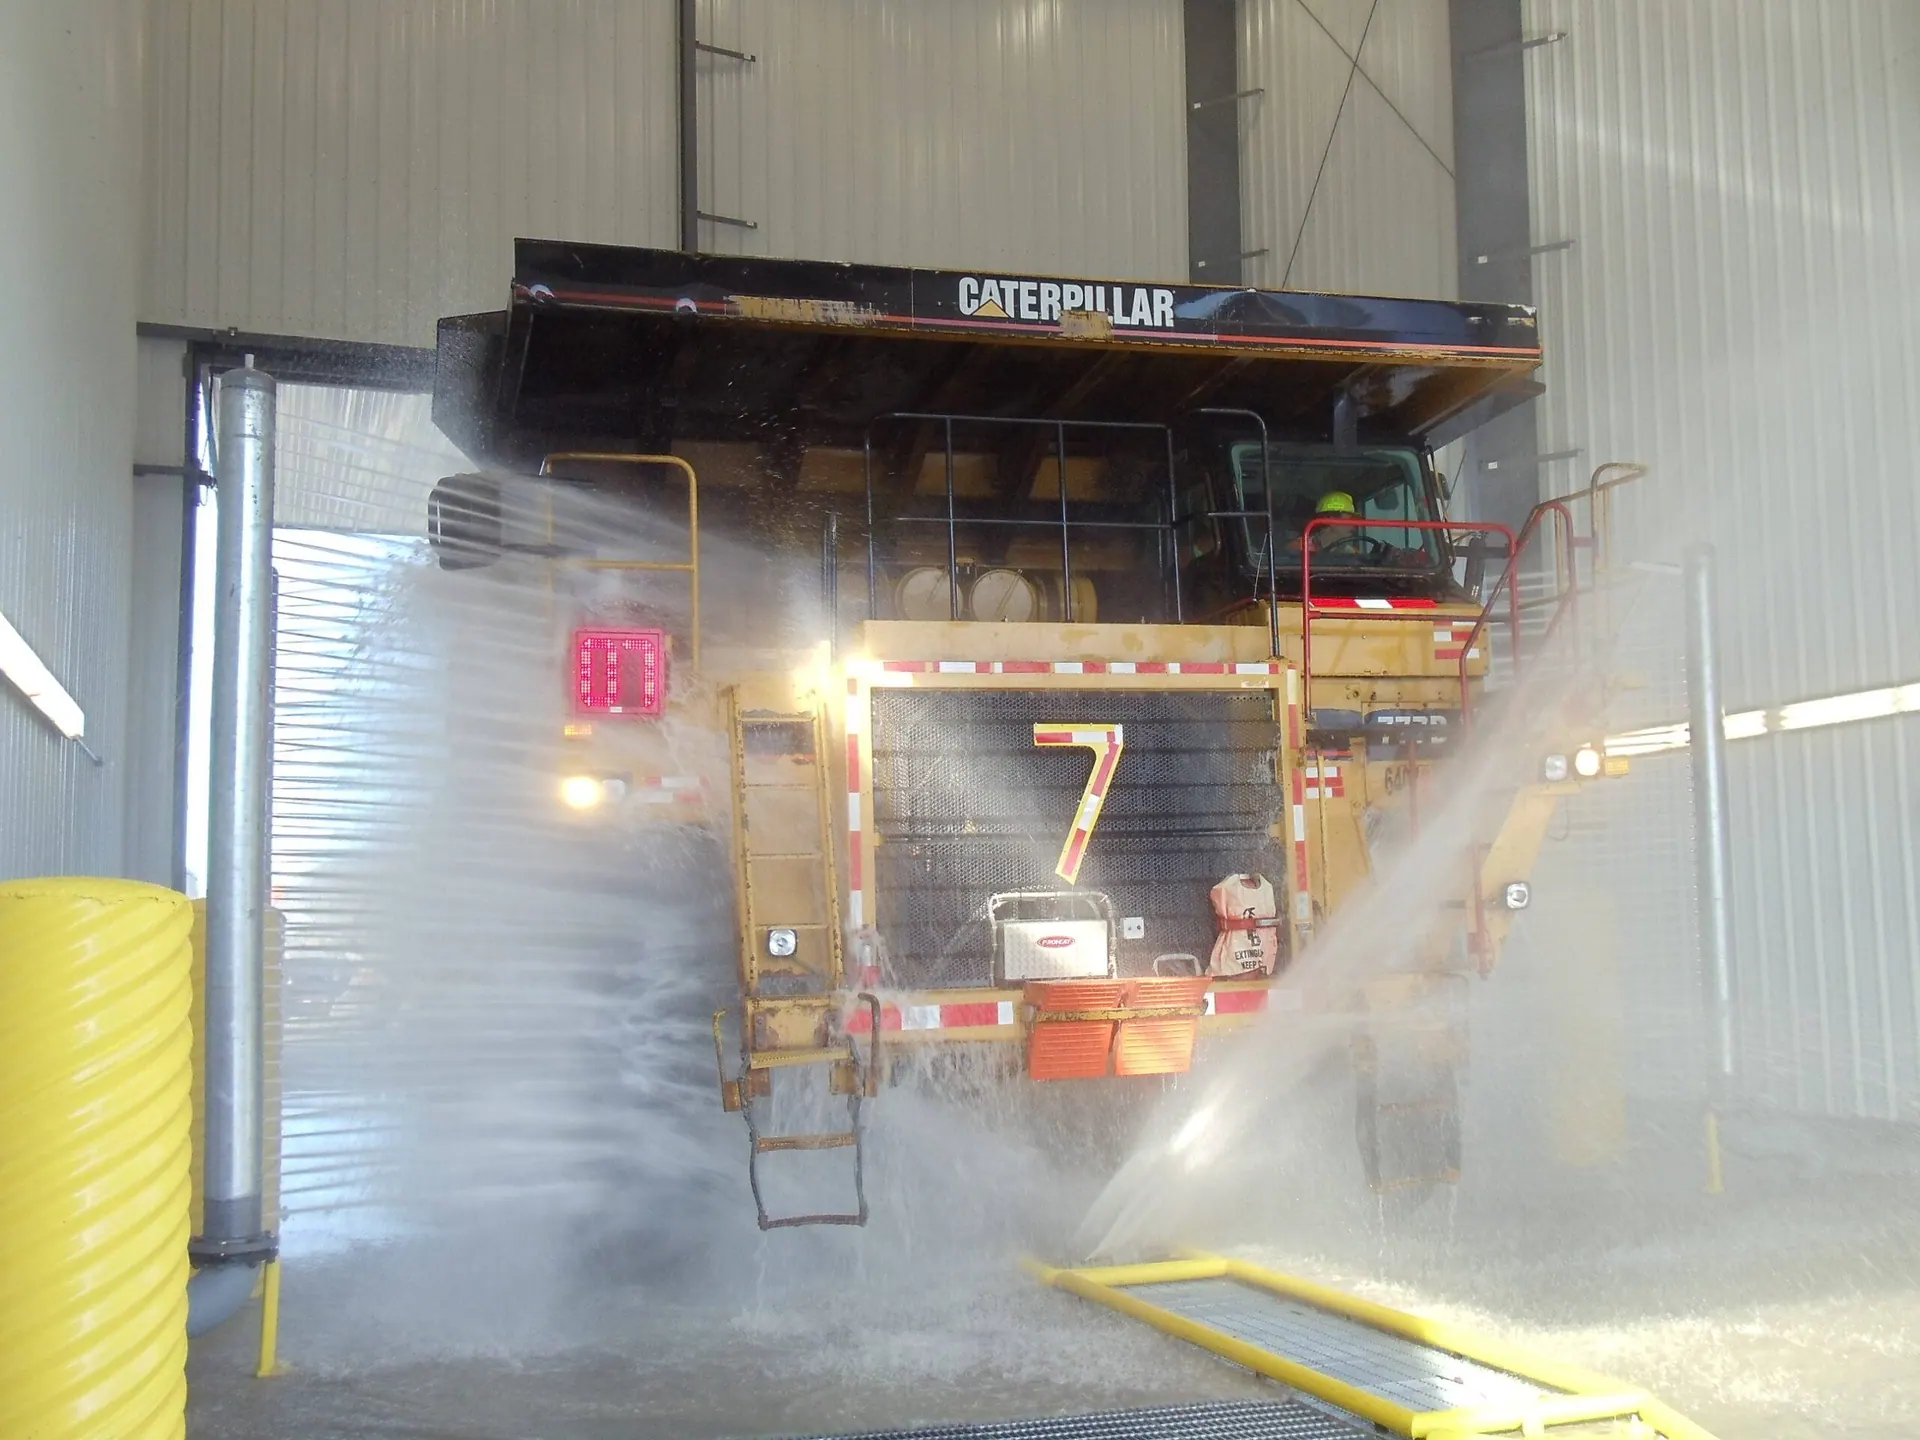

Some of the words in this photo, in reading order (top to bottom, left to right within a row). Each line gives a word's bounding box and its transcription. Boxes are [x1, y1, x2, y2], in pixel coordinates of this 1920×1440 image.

[958, 276, 1175, 328] CATERPILLAR
[1033, 723, 1124, 886] 7
[1241, 960, 1257, 969] KEEP
